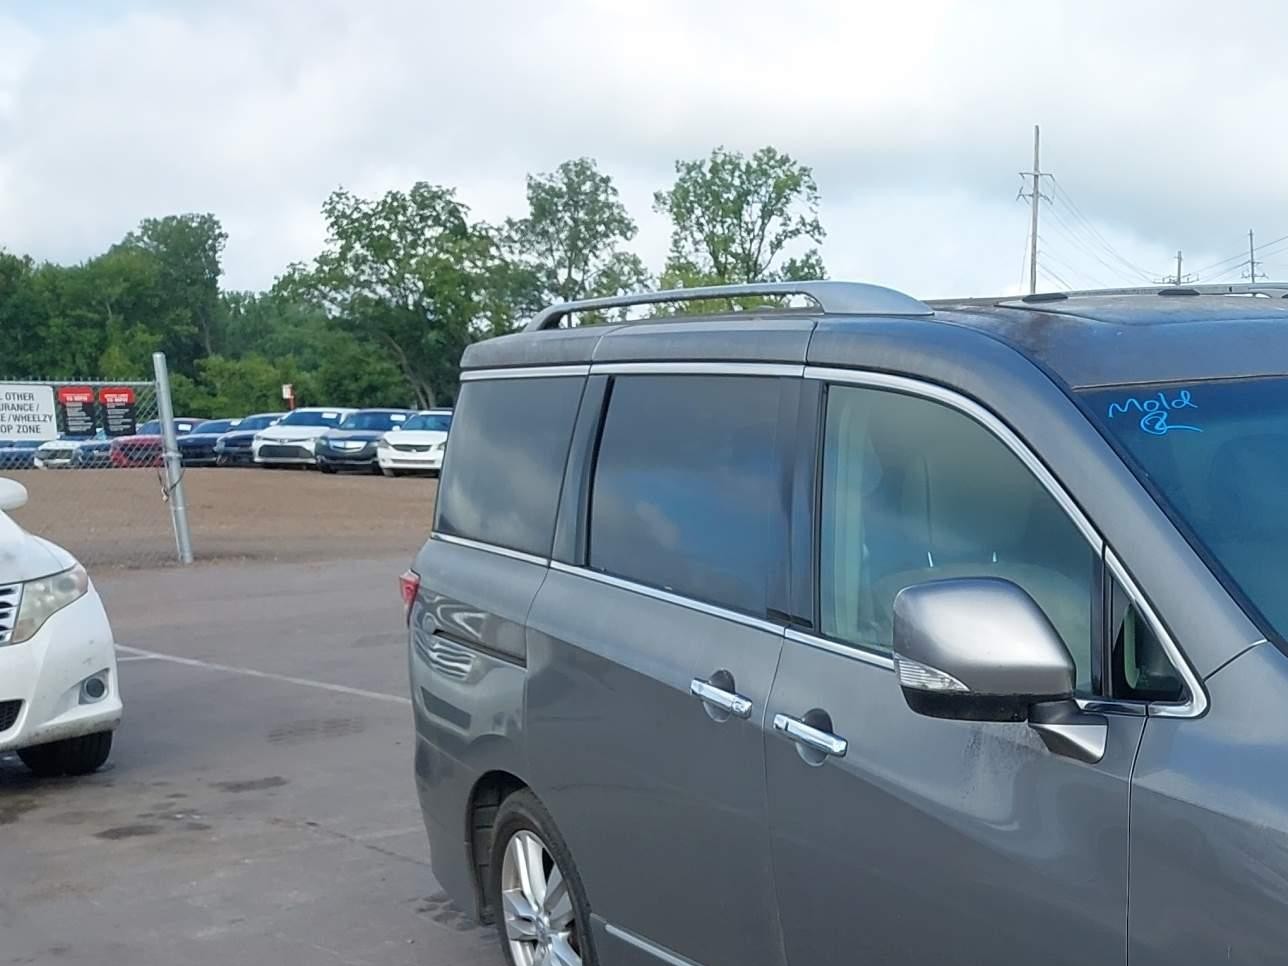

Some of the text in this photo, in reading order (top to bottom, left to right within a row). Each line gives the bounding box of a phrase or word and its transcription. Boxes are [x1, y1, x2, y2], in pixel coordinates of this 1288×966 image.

[5, 392, 34, 401] OTHER
[1108, 390, 1198, 418] Mold
[17, 425, 41, 433] ZONE
